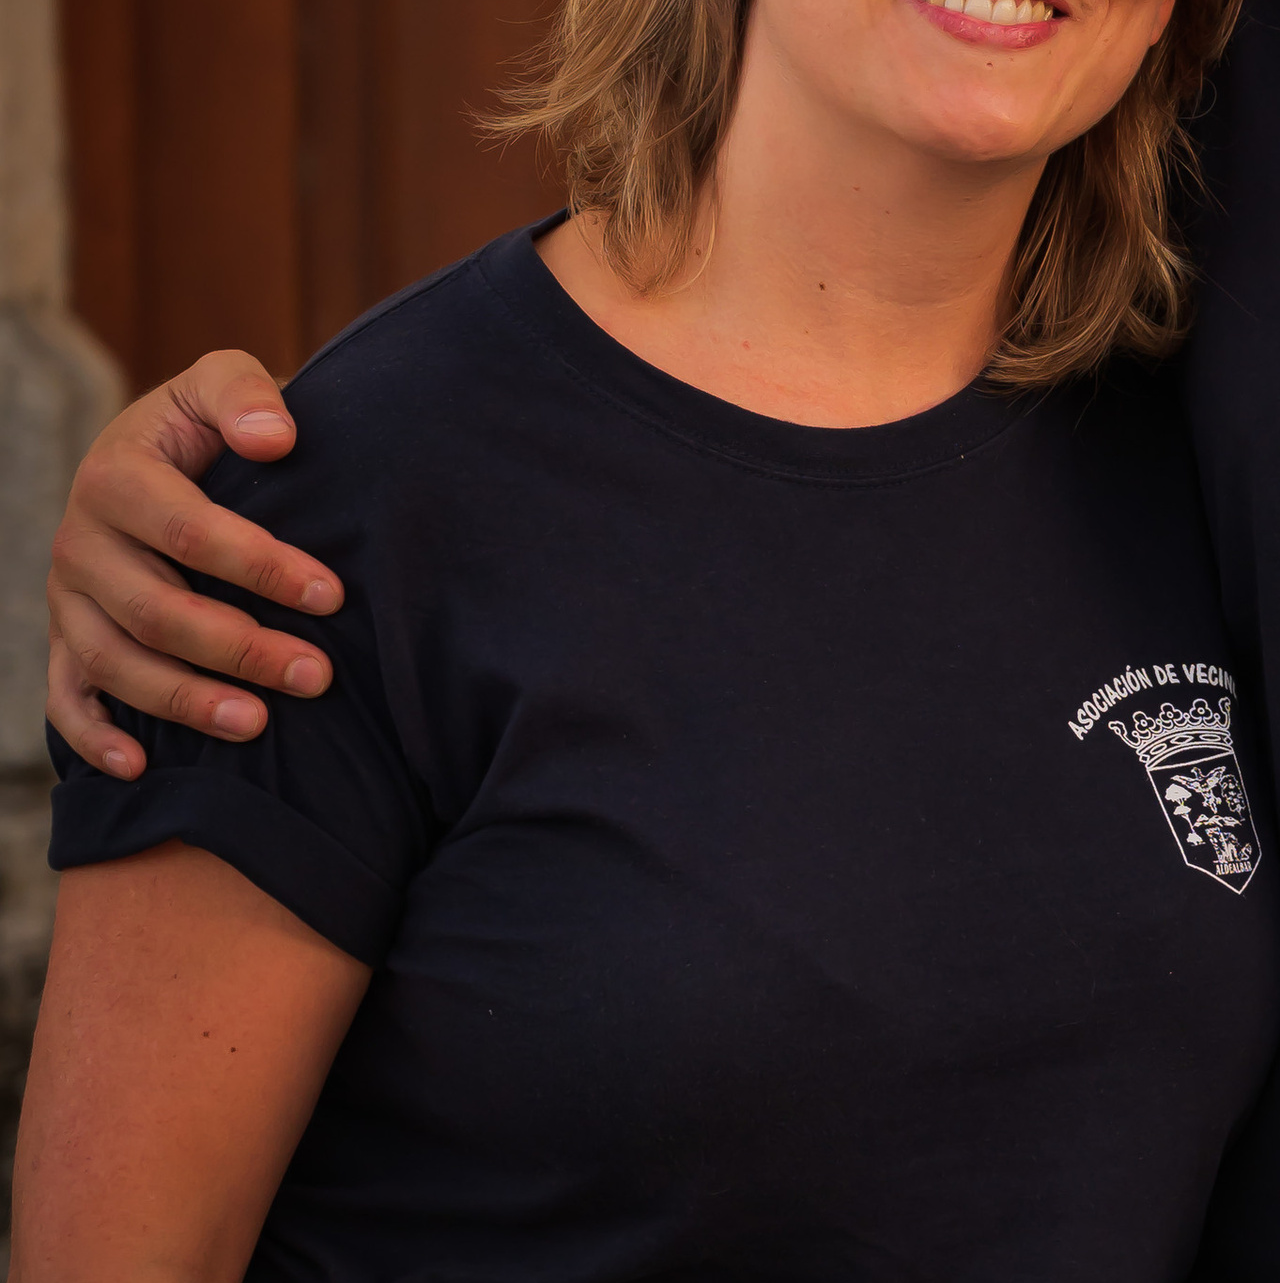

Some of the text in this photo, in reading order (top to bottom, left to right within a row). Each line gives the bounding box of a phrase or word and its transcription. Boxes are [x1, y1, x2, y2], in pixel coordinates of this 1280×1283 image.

[1067, 662, 1238, 741] ASOCIACIÓN DE VECIN
